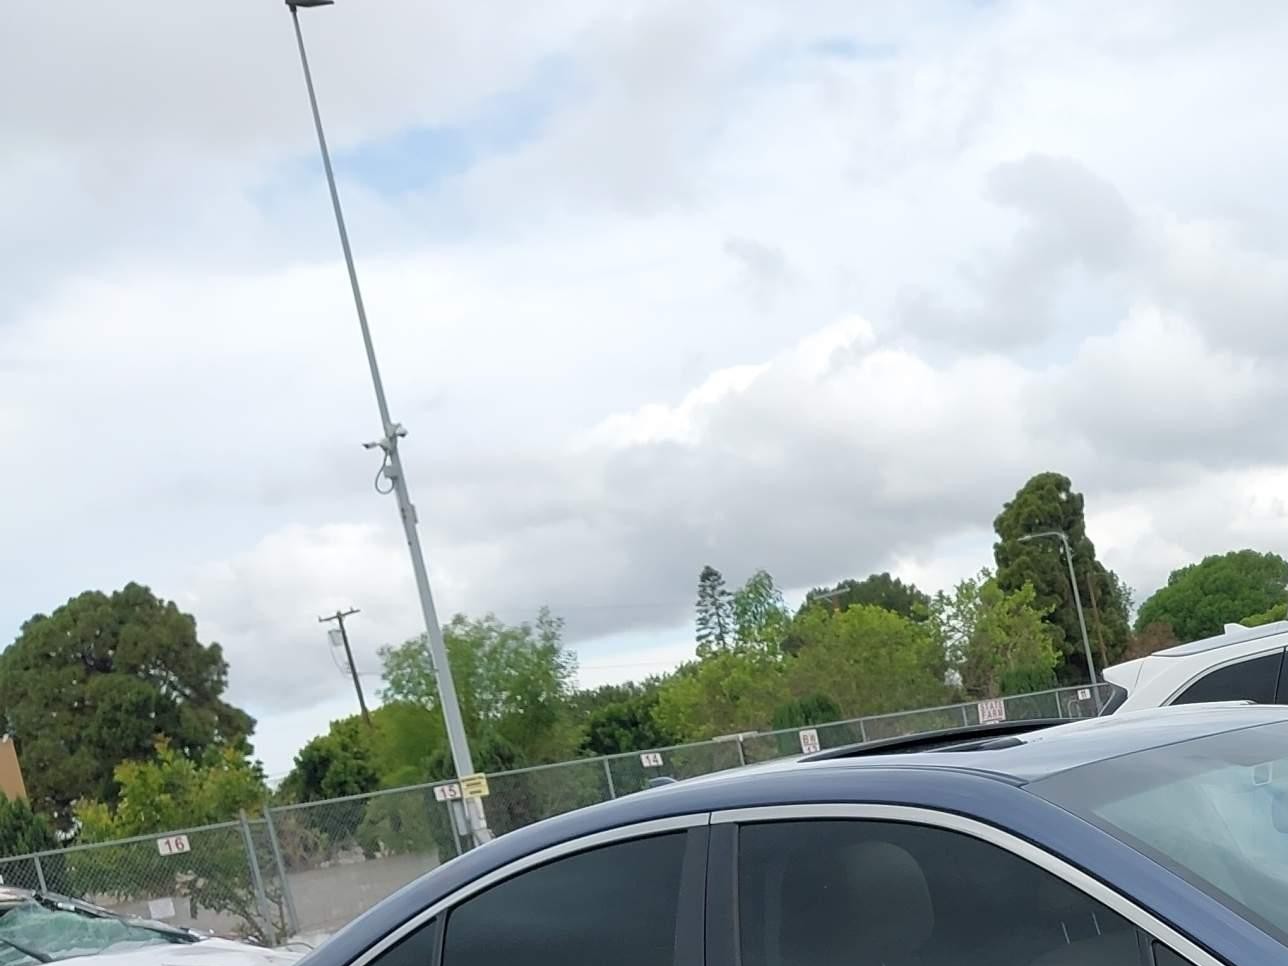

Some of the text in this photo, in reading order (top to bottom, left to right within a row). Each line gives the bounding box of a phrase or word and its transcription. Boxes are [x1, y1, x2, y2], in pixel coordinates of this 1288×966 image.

[645, 754, 659, 766] 14
[440, 784, 457, 798] 15
[164, 837, 185, 853] 16
